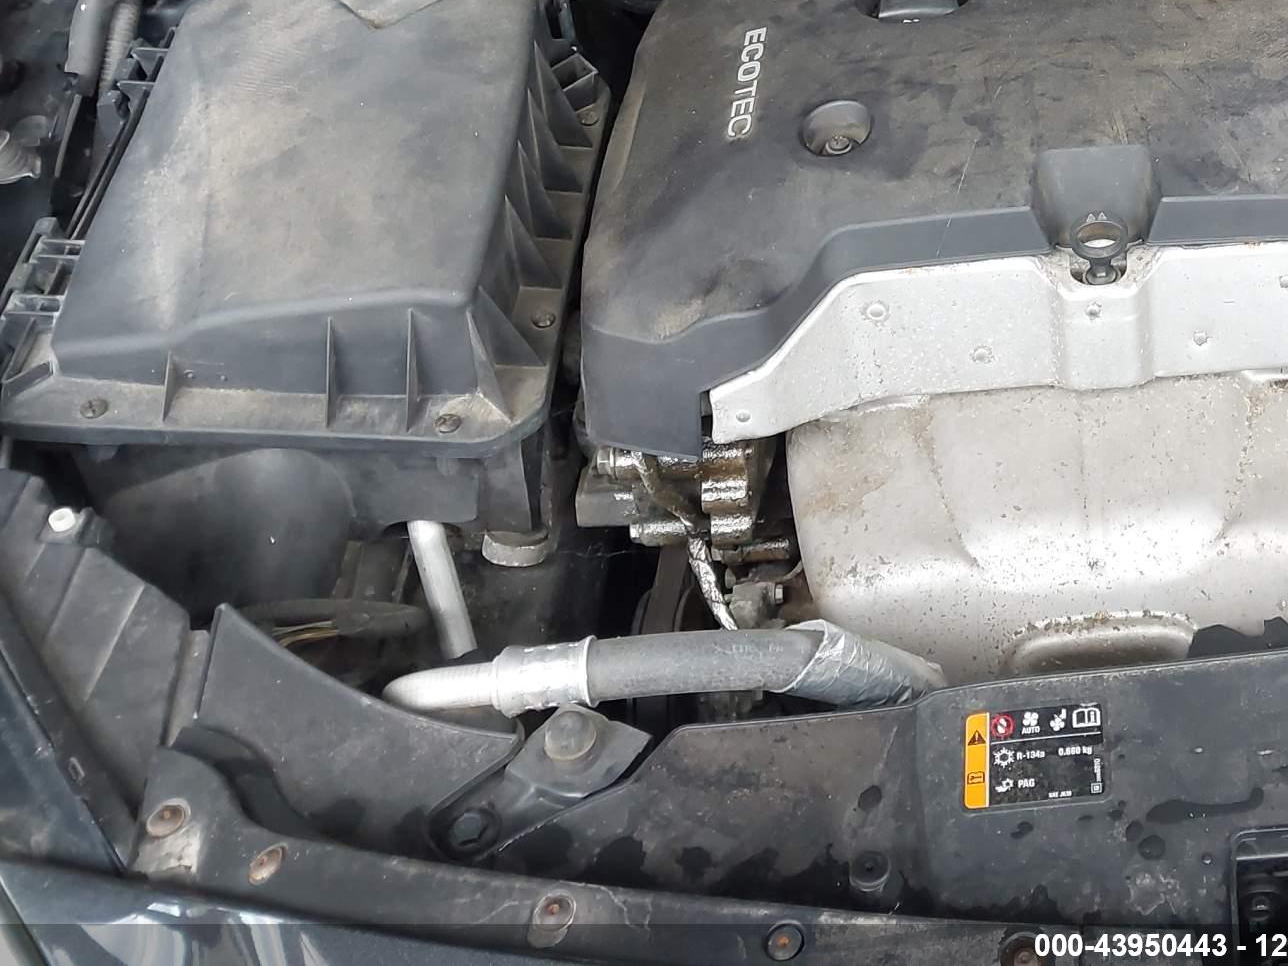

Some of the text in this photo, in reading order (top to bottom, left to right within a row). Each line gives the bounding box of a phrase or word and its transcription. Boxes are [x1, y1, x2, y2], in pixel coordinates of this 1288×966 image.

[726, 26, 768, 139] ECOTEC
[1021, 726, 1041, 735] AUTO
[1018, 778, 1035, 788] PAG
